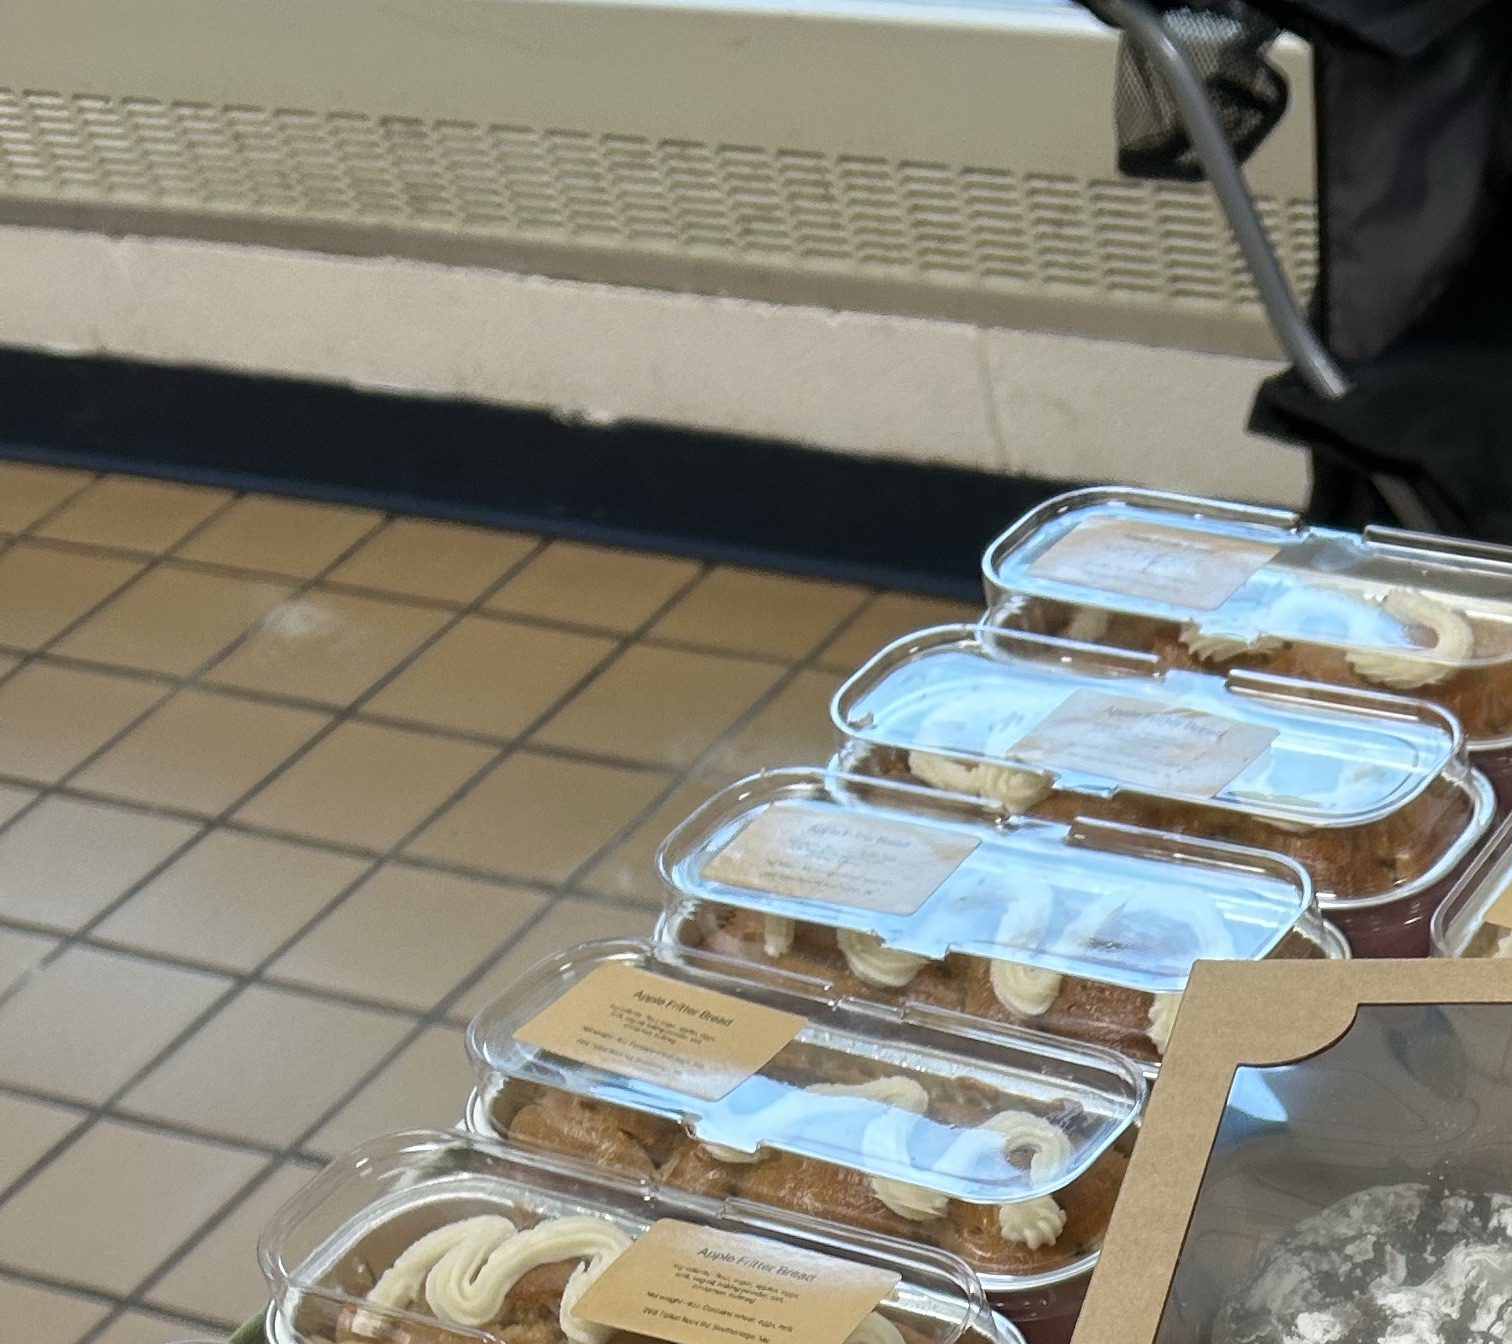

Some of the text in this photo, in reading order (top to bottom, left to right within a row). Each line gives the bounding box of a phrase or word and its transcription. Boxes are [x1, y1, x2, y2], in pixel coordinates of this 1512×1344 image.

[633, 990, 665, 1005] Apple
[697, 1248, 816, 1282] Apple Fritter Bread
